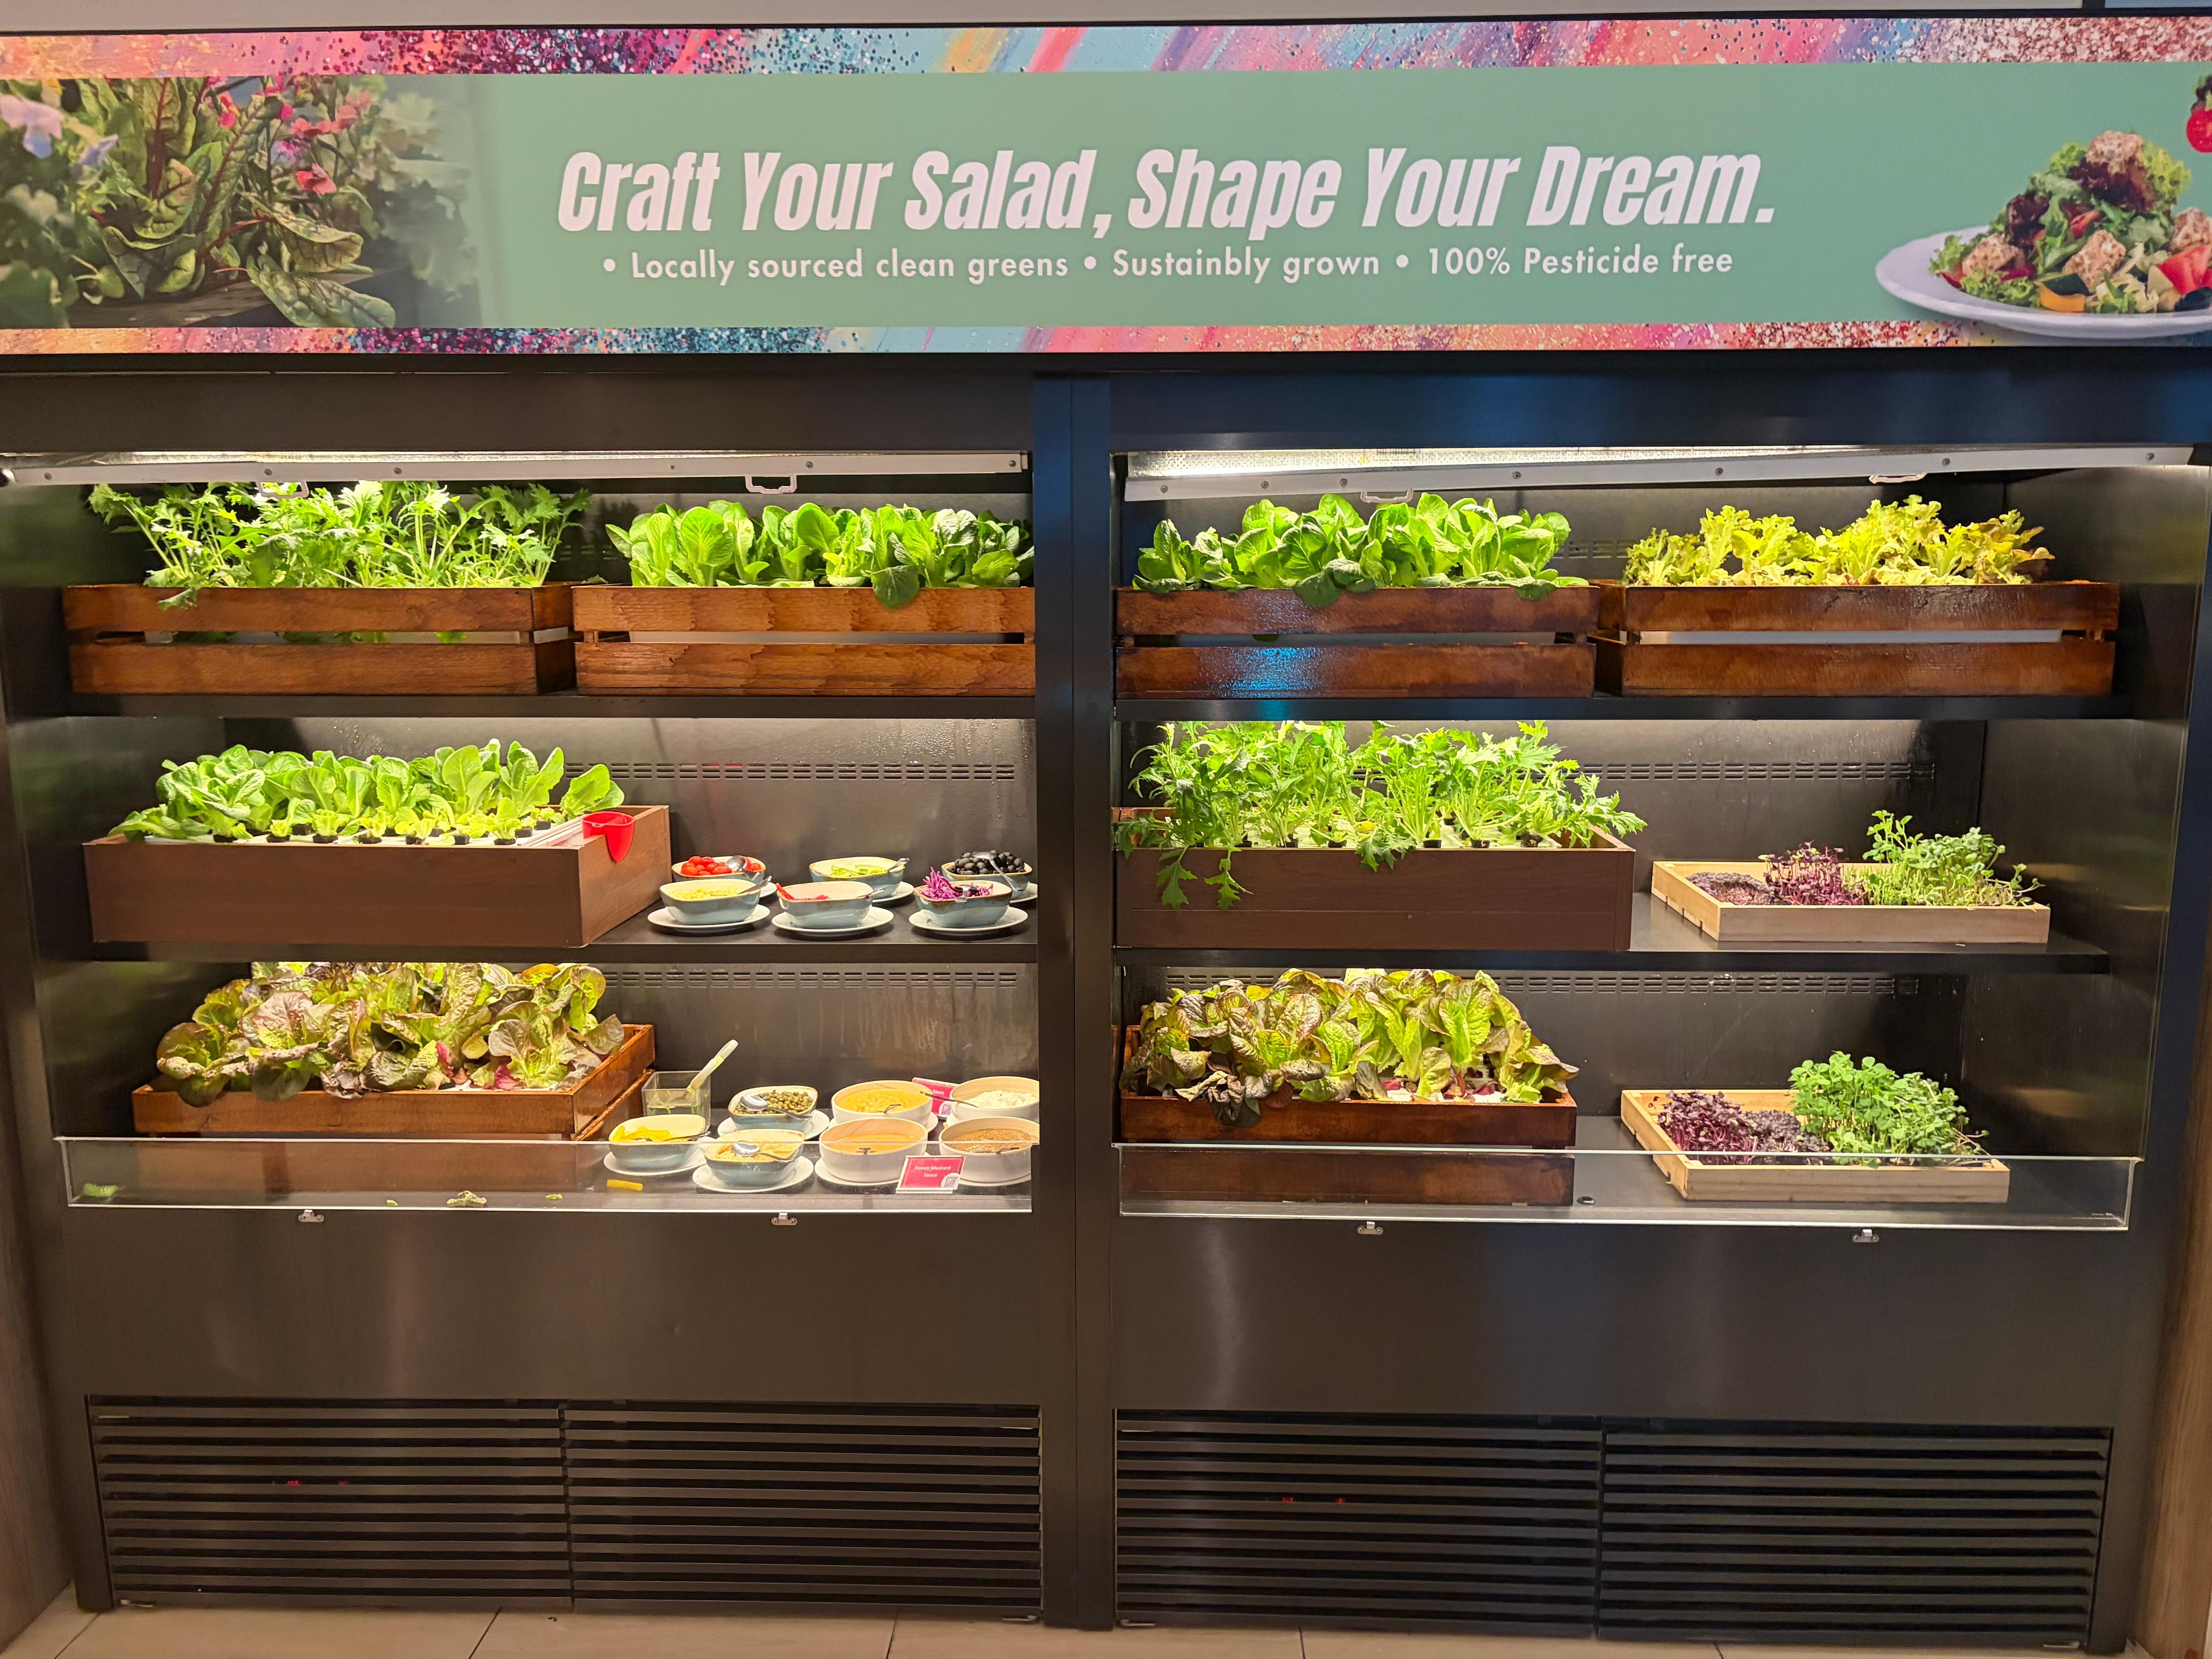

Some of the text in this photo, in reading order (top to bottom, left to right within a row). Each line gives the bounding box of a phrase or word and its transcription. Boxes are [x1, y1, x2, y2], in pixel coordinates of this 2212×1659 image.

[557, 146, 1774, 242] Craft Your Salad, Shape Your Dream.
[631, 243, 1733, 287] Locally sourced clean greens Sustainbly grown 100% Pesticide free
